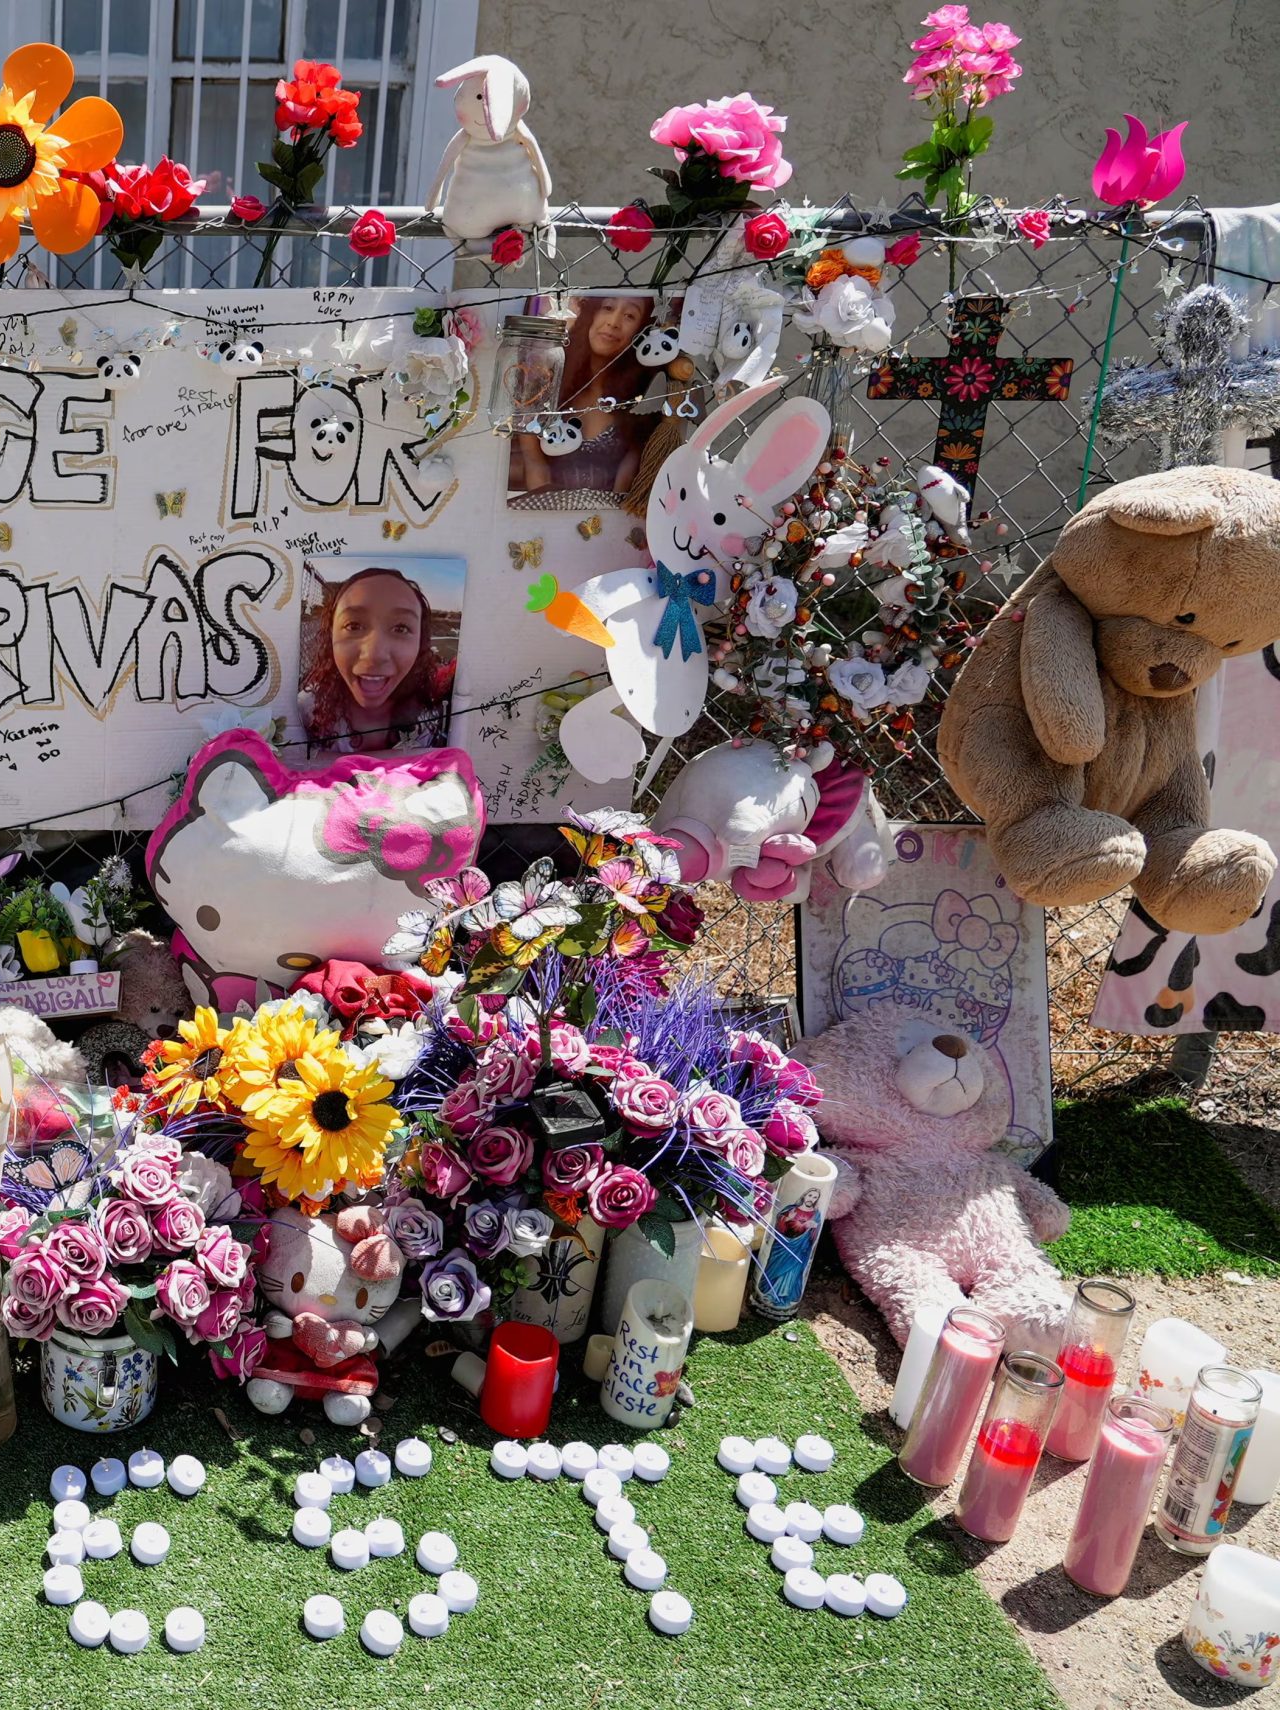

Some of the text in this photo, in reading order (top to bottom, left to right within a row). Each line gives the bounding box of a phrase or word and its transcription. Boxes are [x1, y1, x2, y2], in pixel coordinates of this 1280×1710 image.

[233, 304, 264, 315] always
[230, 370, 451, 520] FOR
[46, 975, 87, 989] LOVE
[24, 985, 117, 1016] ABIGAIL
[620, 1320, 660, 1364] Rest
